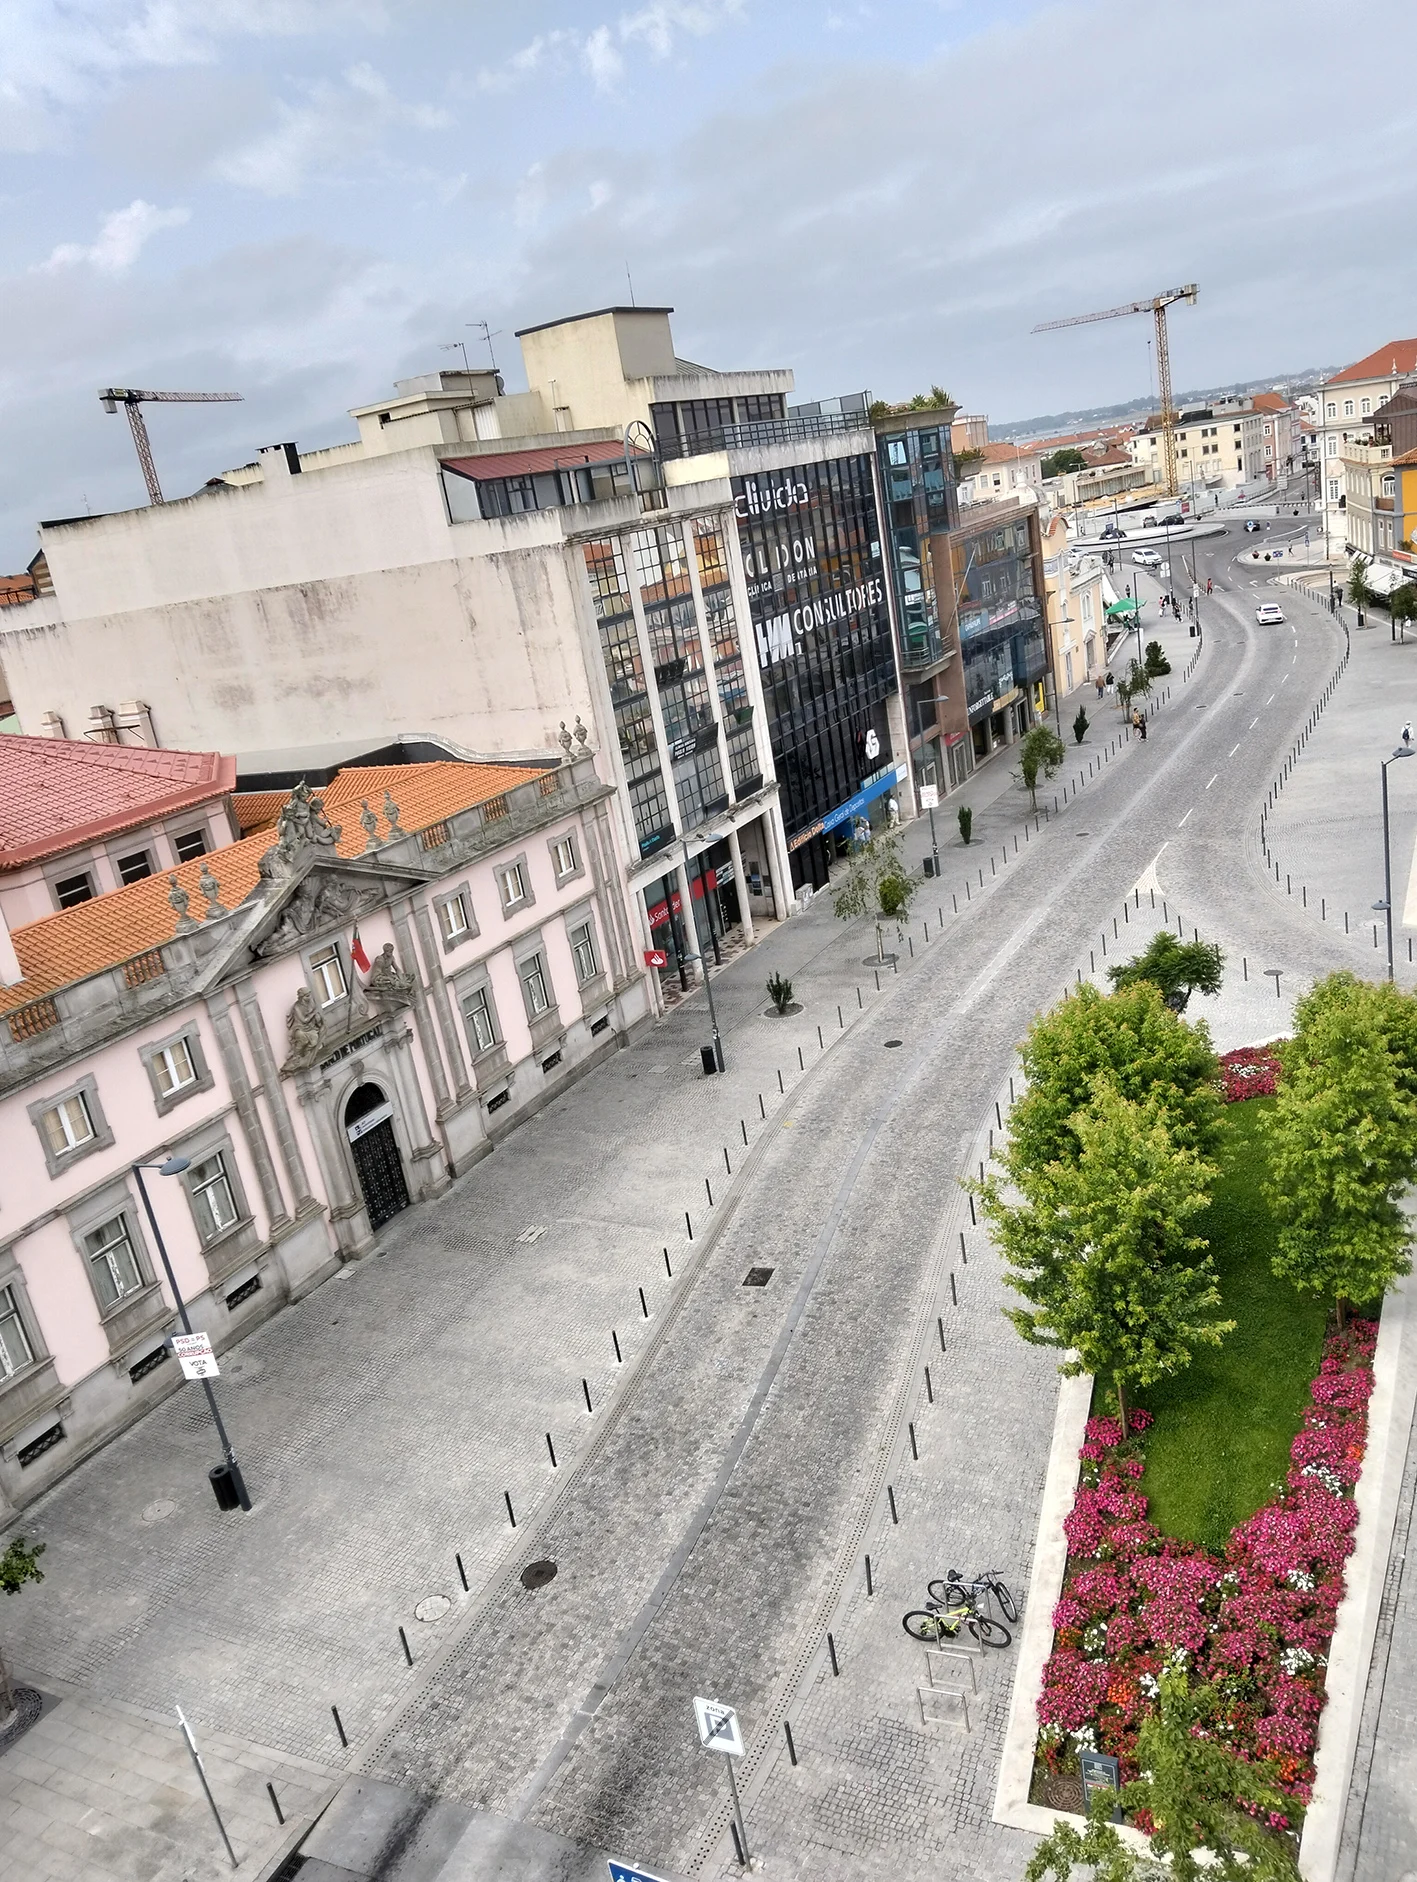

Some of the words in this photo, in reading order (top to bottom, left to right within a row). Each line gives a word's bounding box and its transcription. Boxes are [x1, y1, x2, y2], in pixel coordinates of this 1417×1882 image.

[793, 579, 883, 635] CONSULTORES
[654, 900, 680, 922] Santder
[189, 1359, 207, 1367] VOTA
